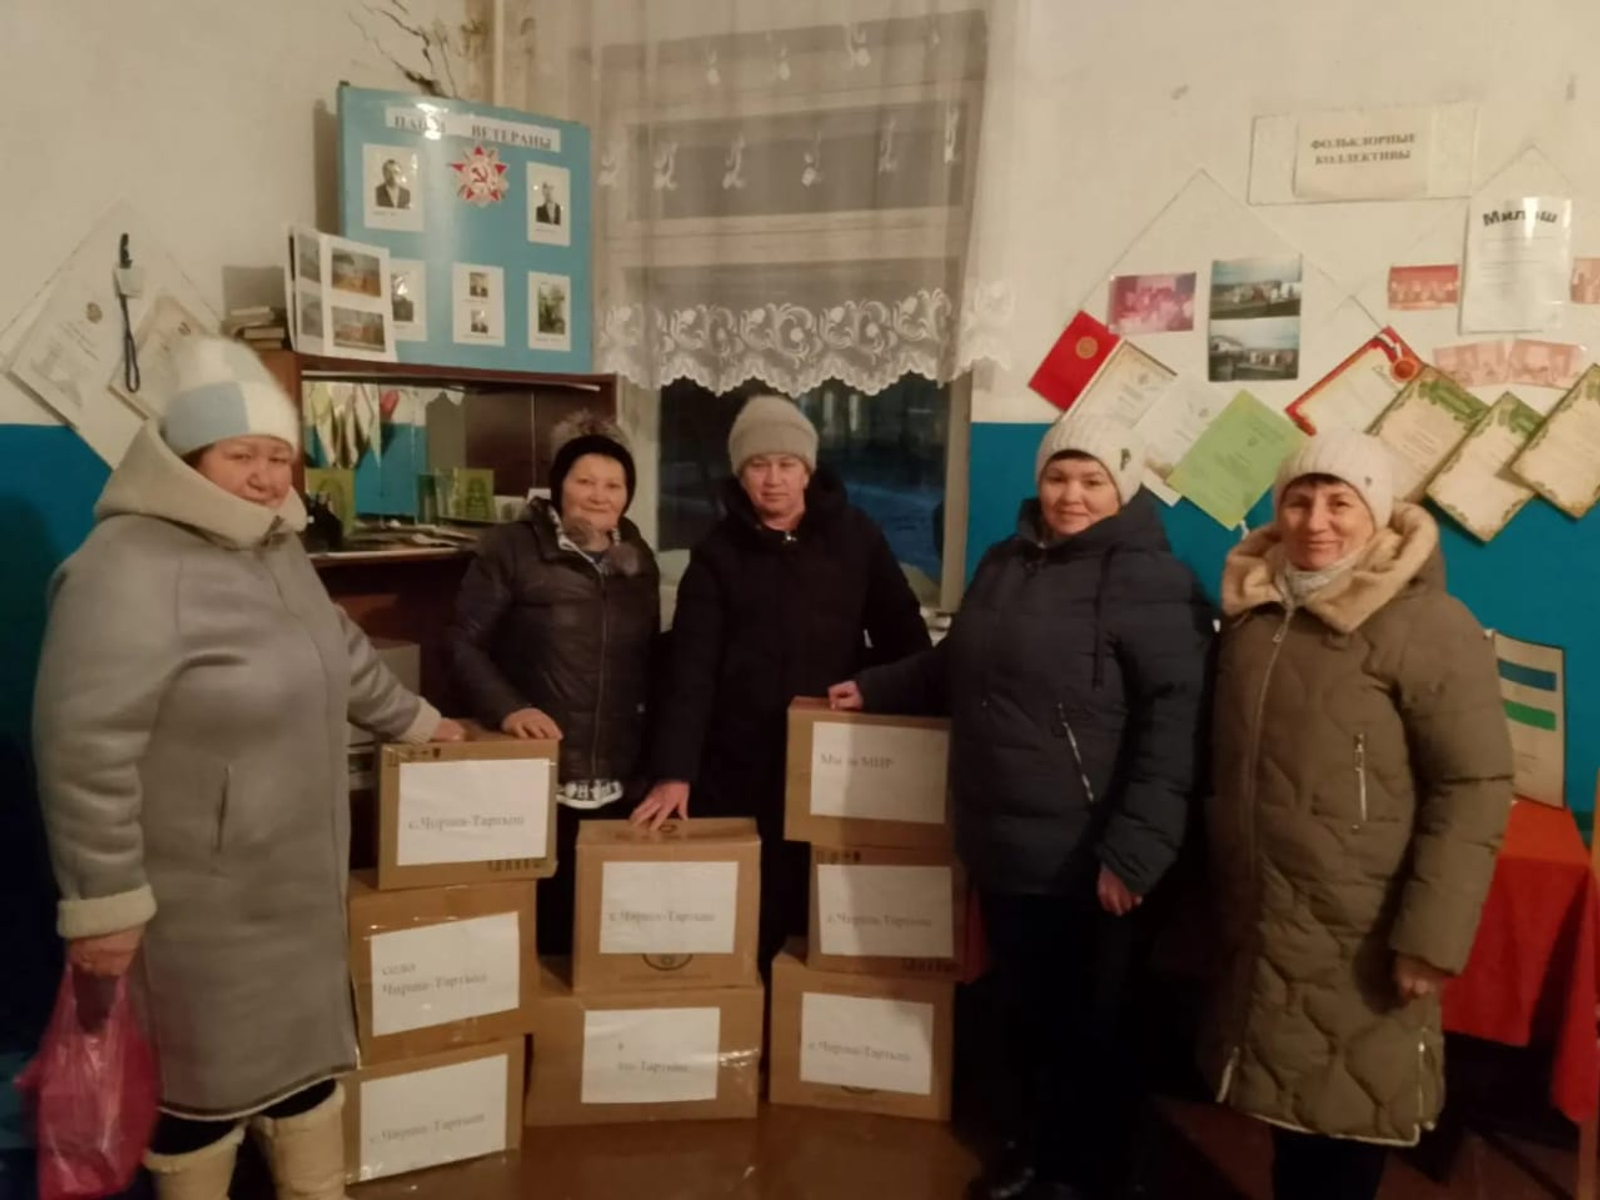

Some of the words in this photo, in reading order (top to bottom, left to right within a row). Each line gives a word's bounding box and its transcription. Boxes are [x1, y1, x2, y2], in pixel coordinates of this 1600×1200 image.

[471, 124, 552, 149] ВЕТЕРАНЫ
[1311, 133, 1415, 150] ФОЛЬКЛОРНЫЕ
[1315, 150, 1411, 166] КОЛЛЕКТИВЫ
[1483, 210, 1558, 227] Милш
